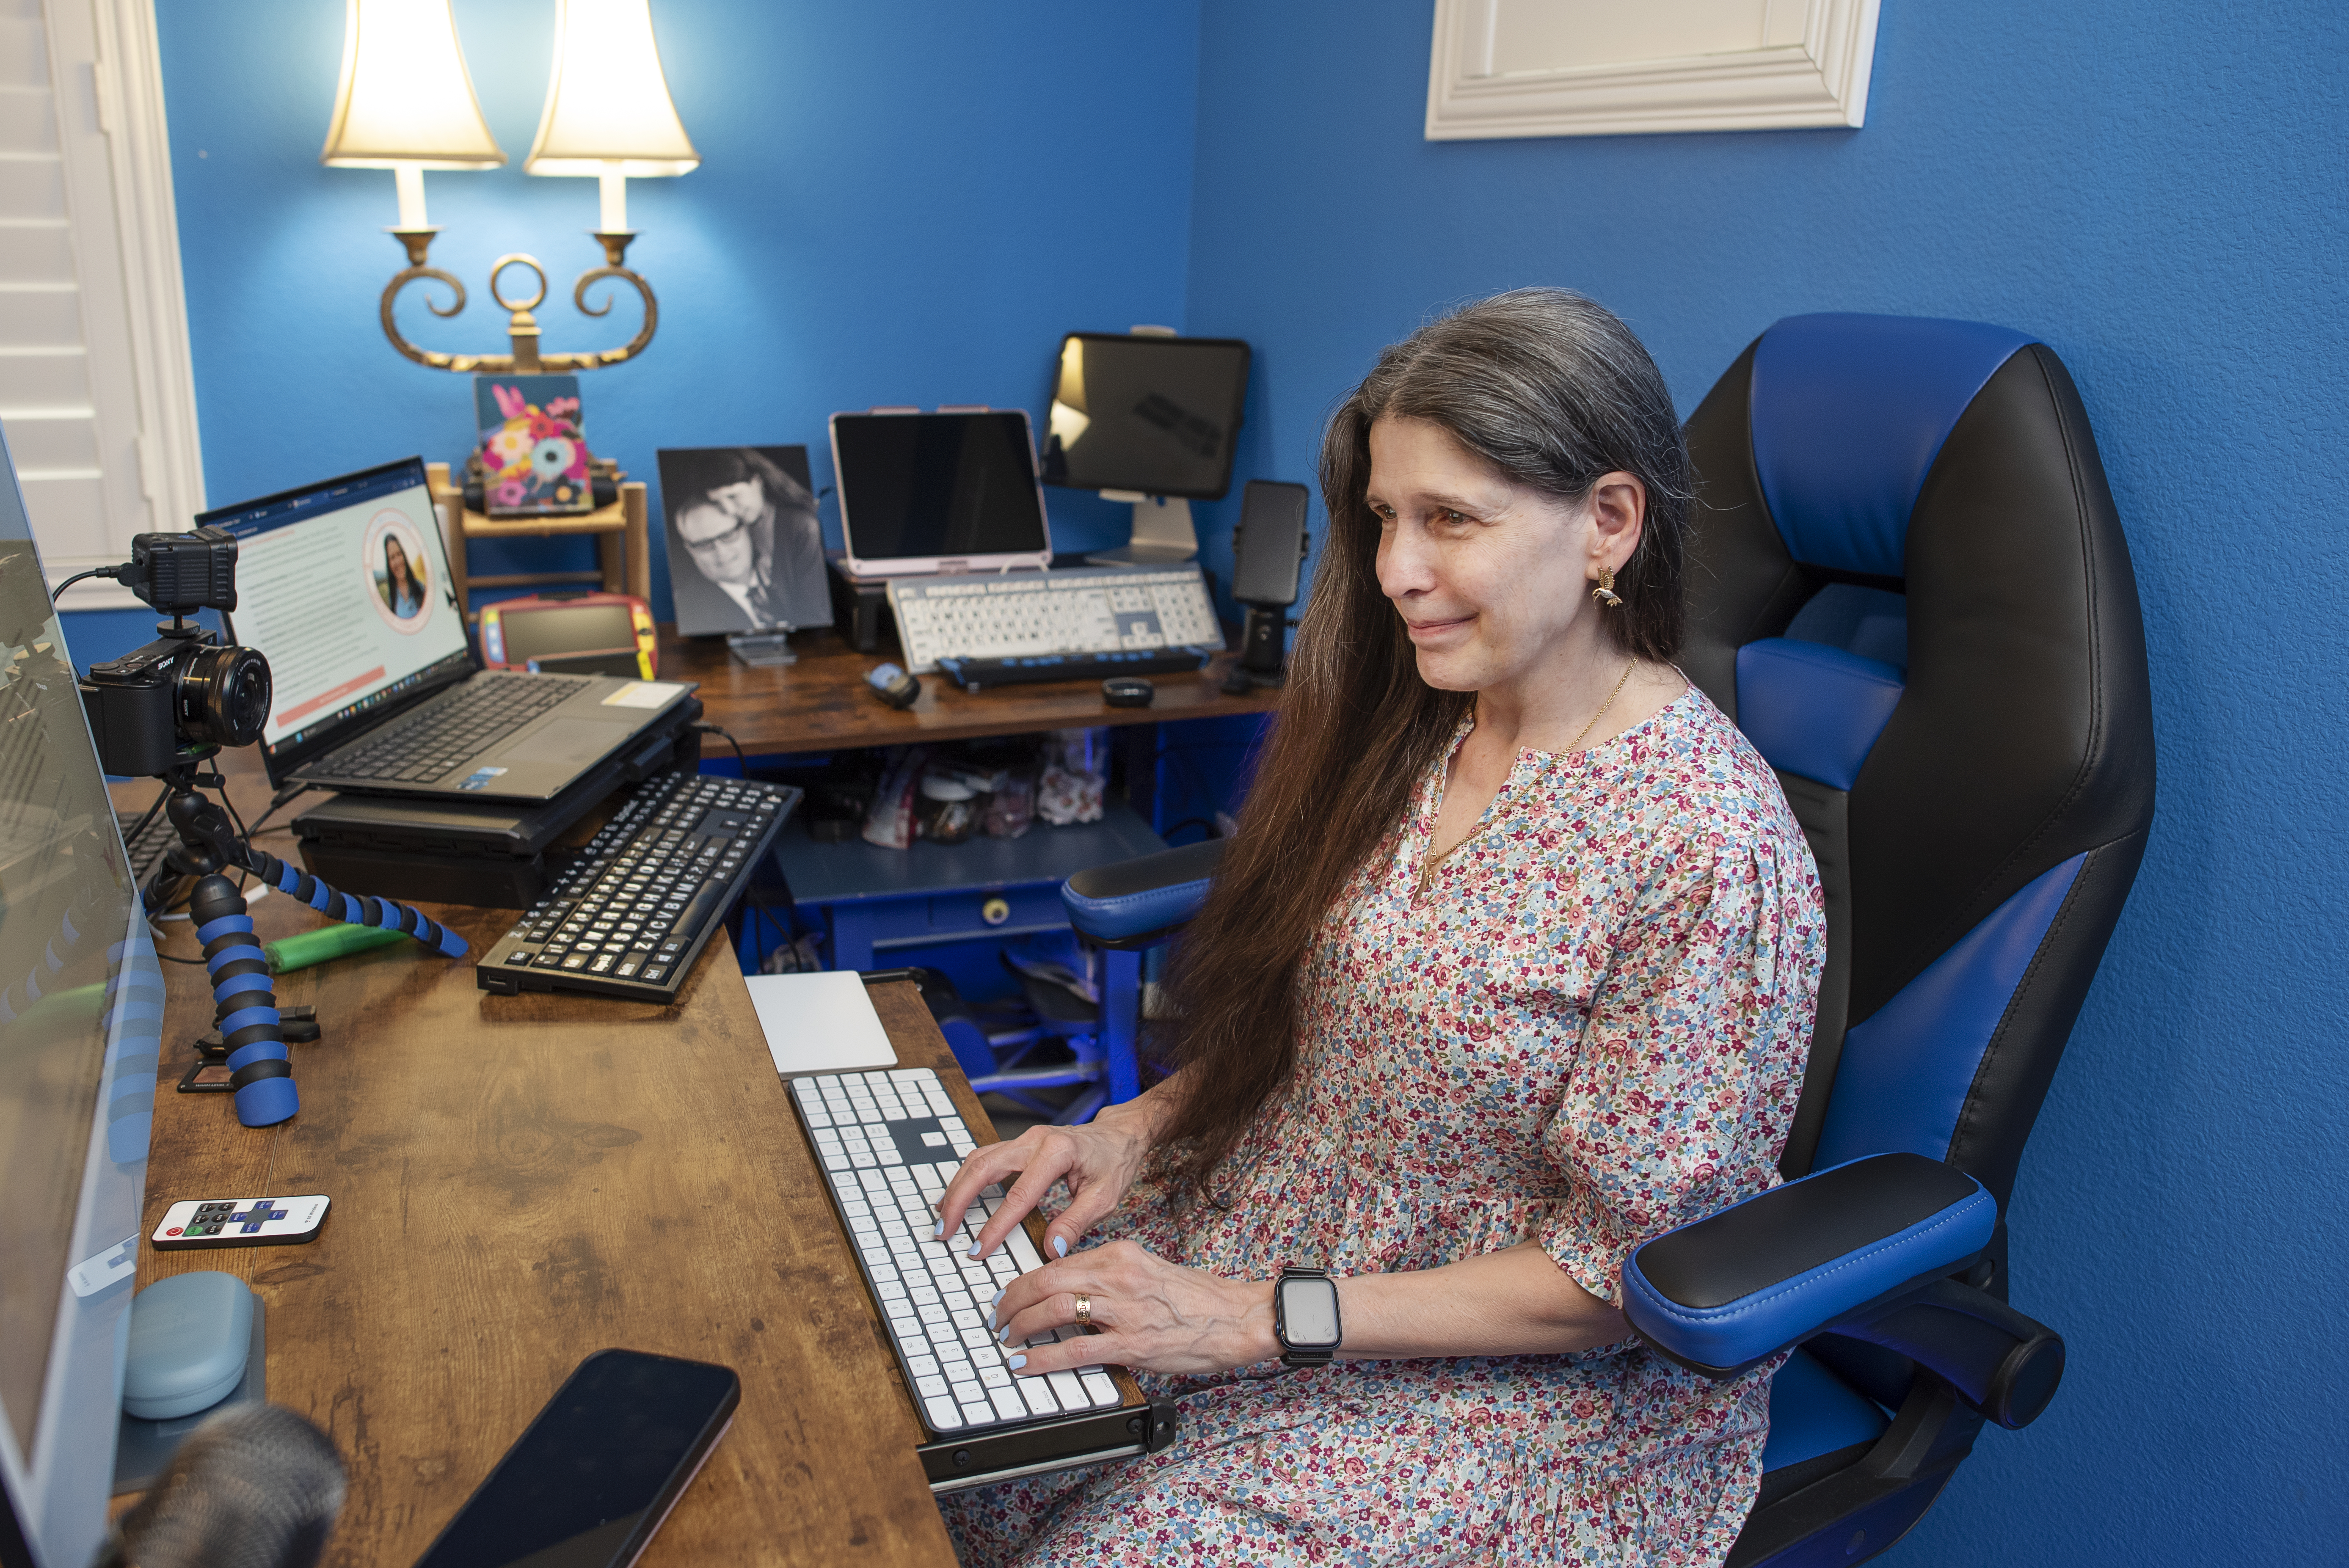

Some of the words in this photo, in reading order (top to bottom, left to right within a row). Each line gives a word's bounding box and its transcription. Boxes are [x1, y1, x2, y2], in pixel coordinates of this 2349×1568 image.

[158, 656, 174, 670] SONY
[656, 875, 674, 884] K
[624, 883, 642, 891] U
[677, 883, 695, 892] M
[643, 893, 661, 901] H
[670, 892, 688, 901] N
[636, 903, 653, 911] G
[601, 912, 620, 920] R
[656, 910, 673, 918] V
[593, 921, 612, 930] E
[620, 922, 638, 931] D
[650, 920, 667, 929] C
[584, 931, 604, 940] W
[612, 932, 631, 941] S
[642, 931, 660, 940] X
[576, 942, 596, 951] Q
[604, 943, 624, 952] A
[634, 941, 653, 950] Z
[564, 958, 581, 967] Tab
[645, 969, 660, 979] Ctrl
[309, 1204, 318, 1215] Wireless
[1098, 1375, 1110, 1388] control
[1077, 1394, 1085, 1403] shift
